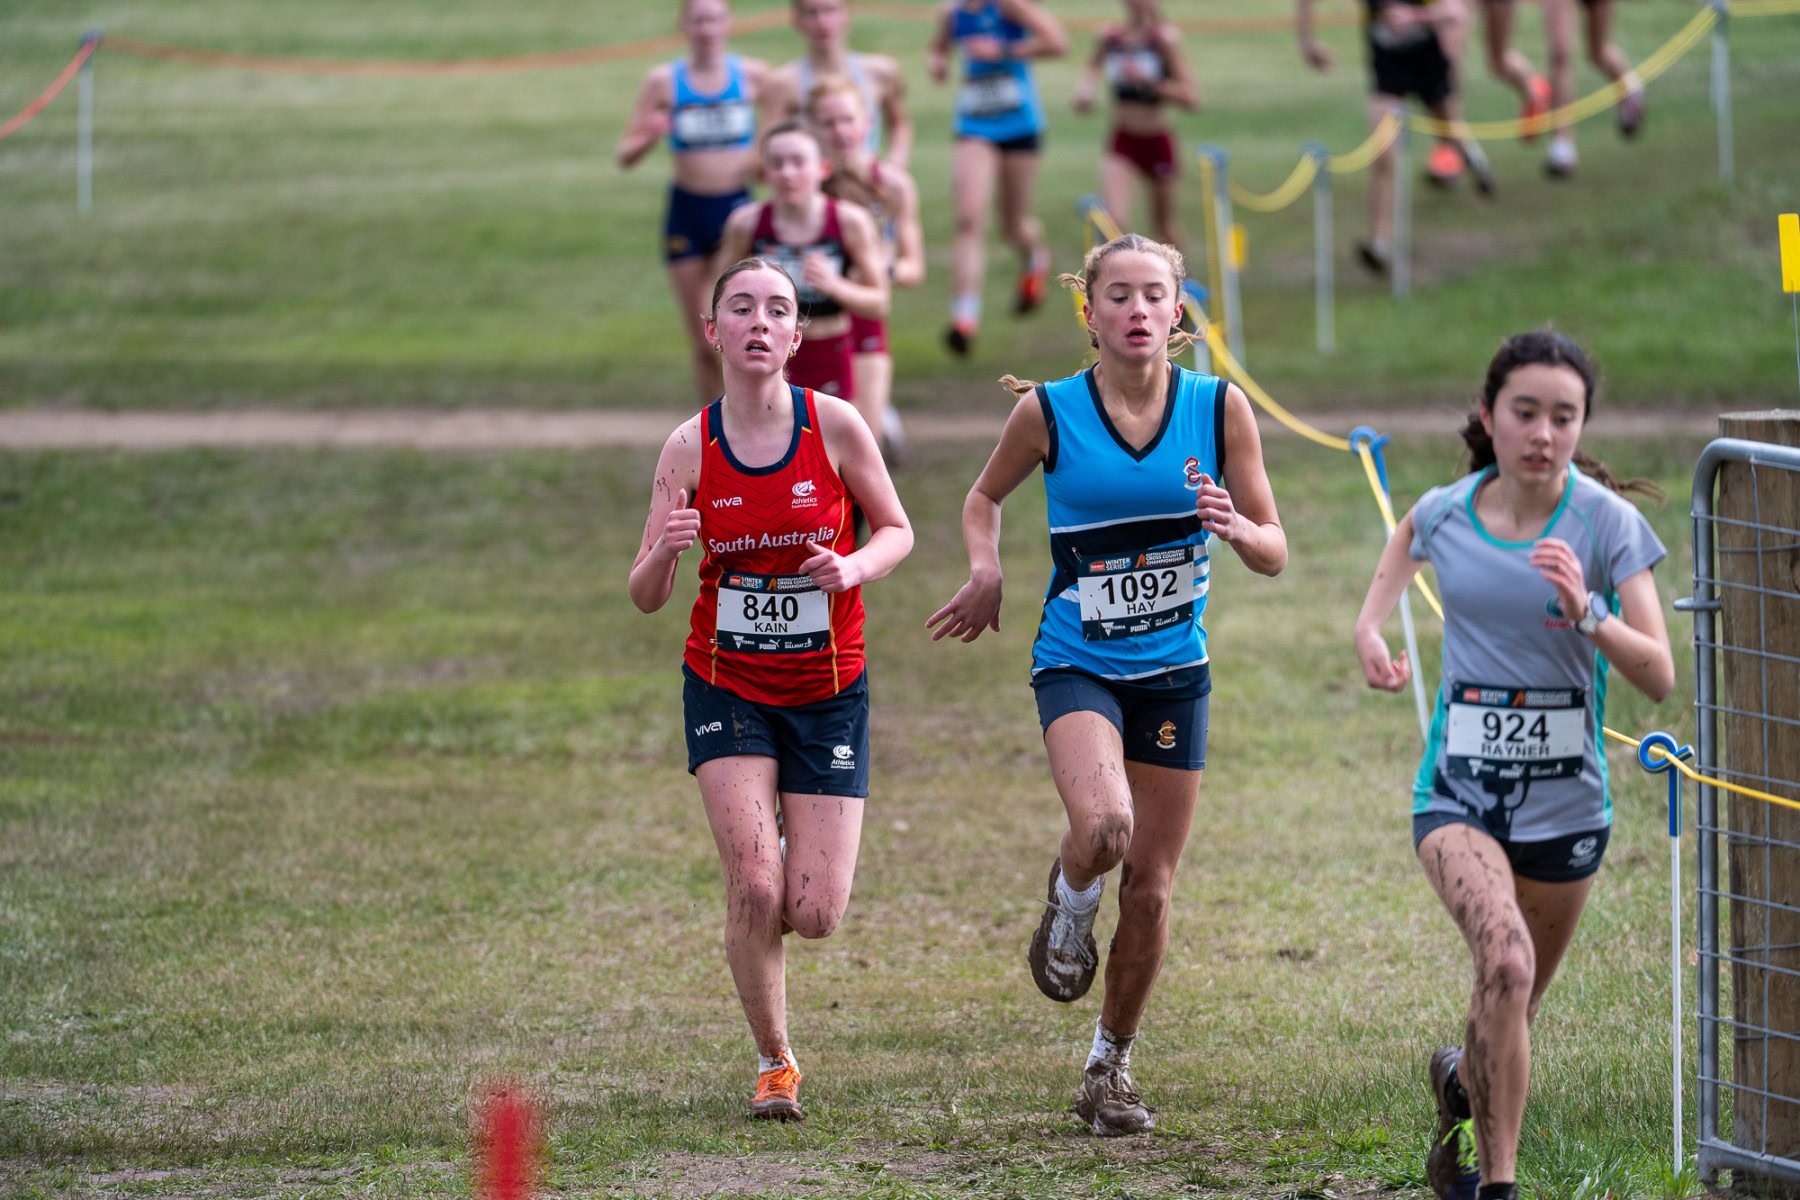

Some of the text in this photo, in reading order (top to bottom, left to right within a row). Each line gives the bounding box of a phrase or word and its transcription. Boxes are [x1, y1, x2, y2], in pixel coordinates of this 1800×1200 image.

[712, 496, 742, 508] viva
[708, 526, 835, 554] South Australia
[1105, 558, 1130, 566] WINTER
[1101, 570, 1178, 604] 1092
[743, 594, 798, 621] 840
[1127, 601, 1156, 614] HAY
[754, 622, 788, 633] KAIN
[695, 721, 722, 736] viva
[1482, 712, 1550, 742] 924
